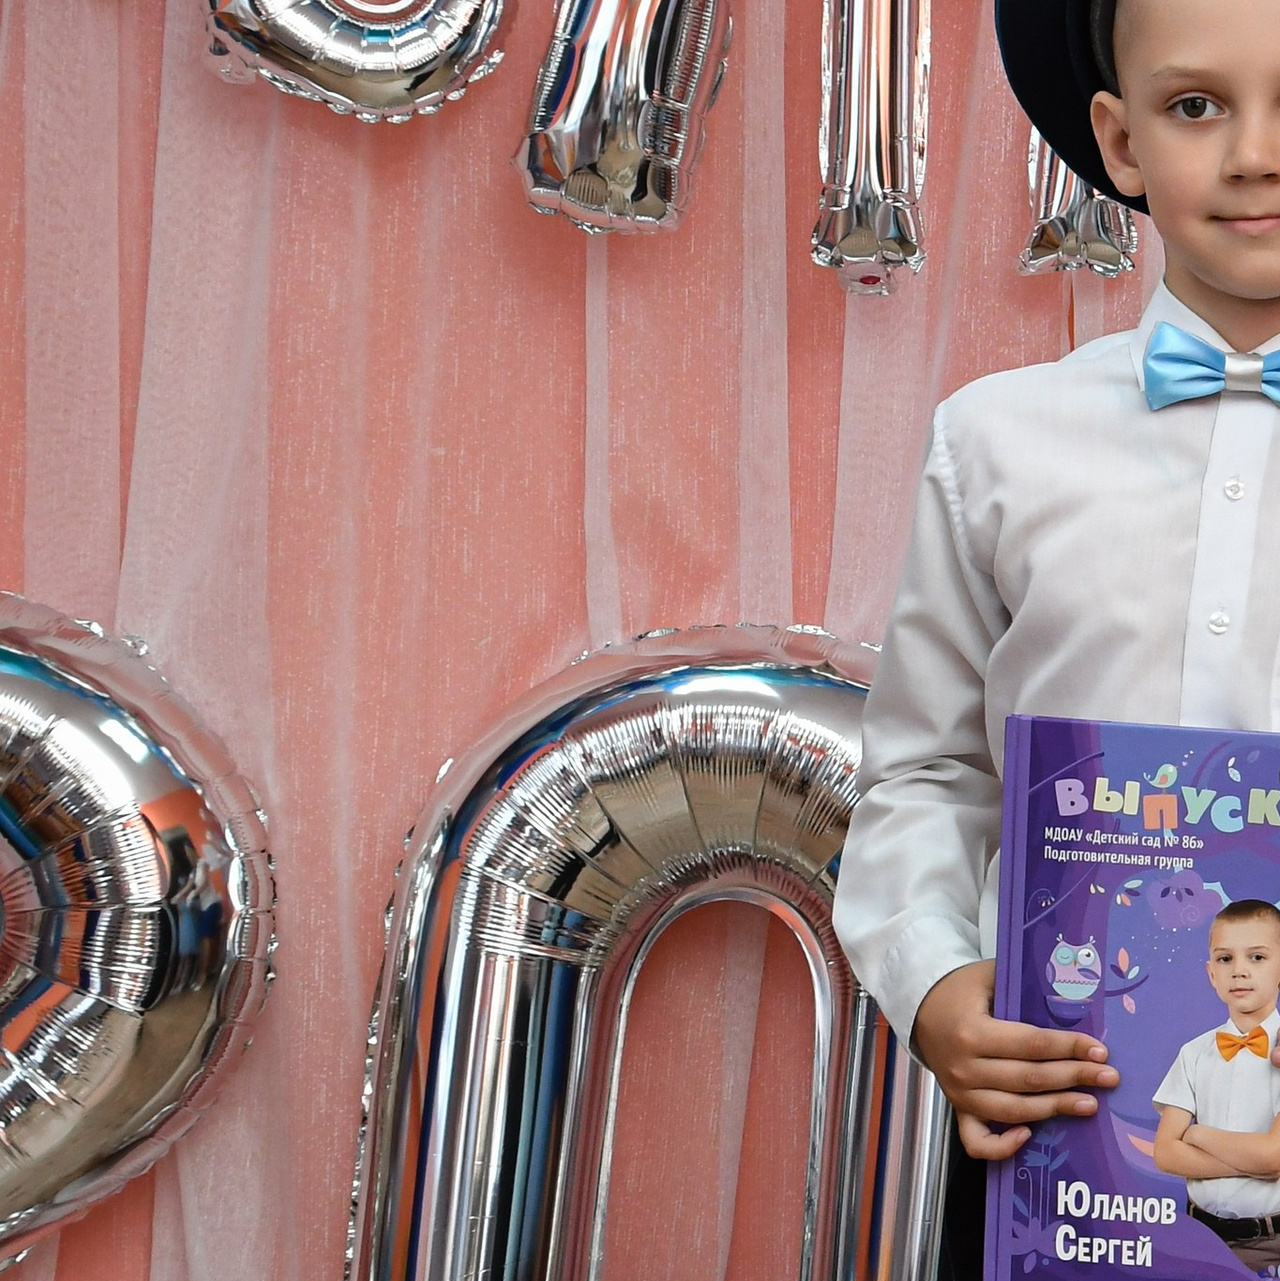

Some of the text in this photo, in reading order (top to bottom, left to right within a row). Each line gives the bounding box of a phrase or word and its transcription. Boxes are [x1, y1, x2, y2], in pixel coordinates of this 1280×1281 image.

[1044, 826, 1204, 850] МДОАУ «Детский сад № 86»
[1044, 845, 1193, 870] Подготовительная группа
